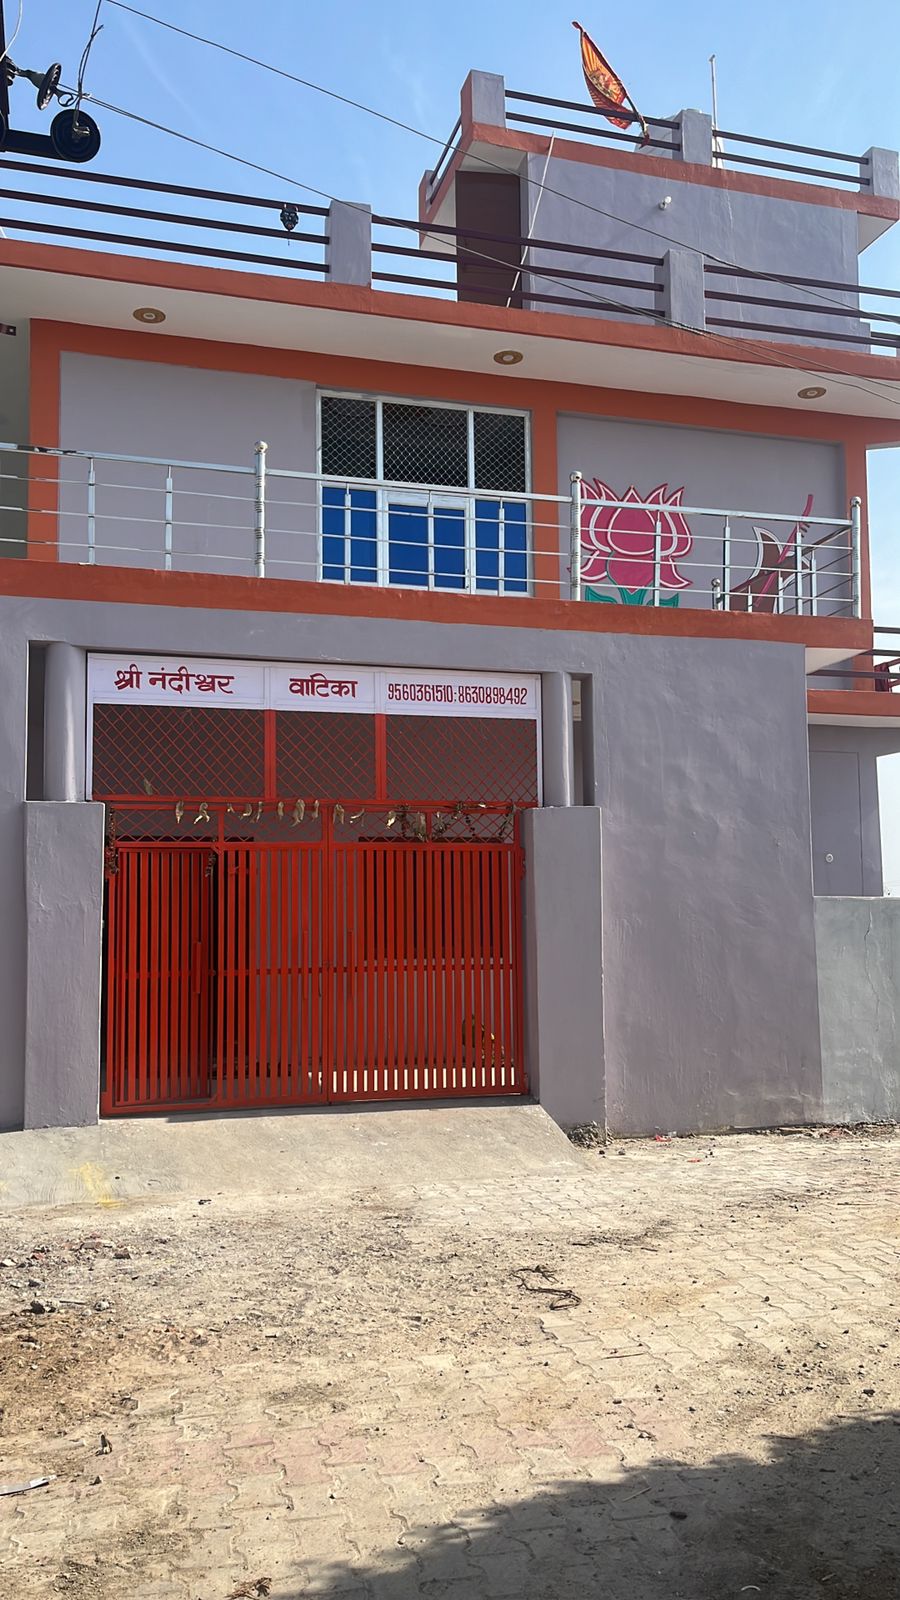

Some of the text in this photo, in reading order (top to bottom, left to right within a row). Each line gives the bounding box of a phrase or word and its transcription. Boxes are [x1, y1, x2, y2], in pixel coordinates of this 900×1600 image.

[114, 663, 358, 698] श्री नंदीश्वर वाटिका
